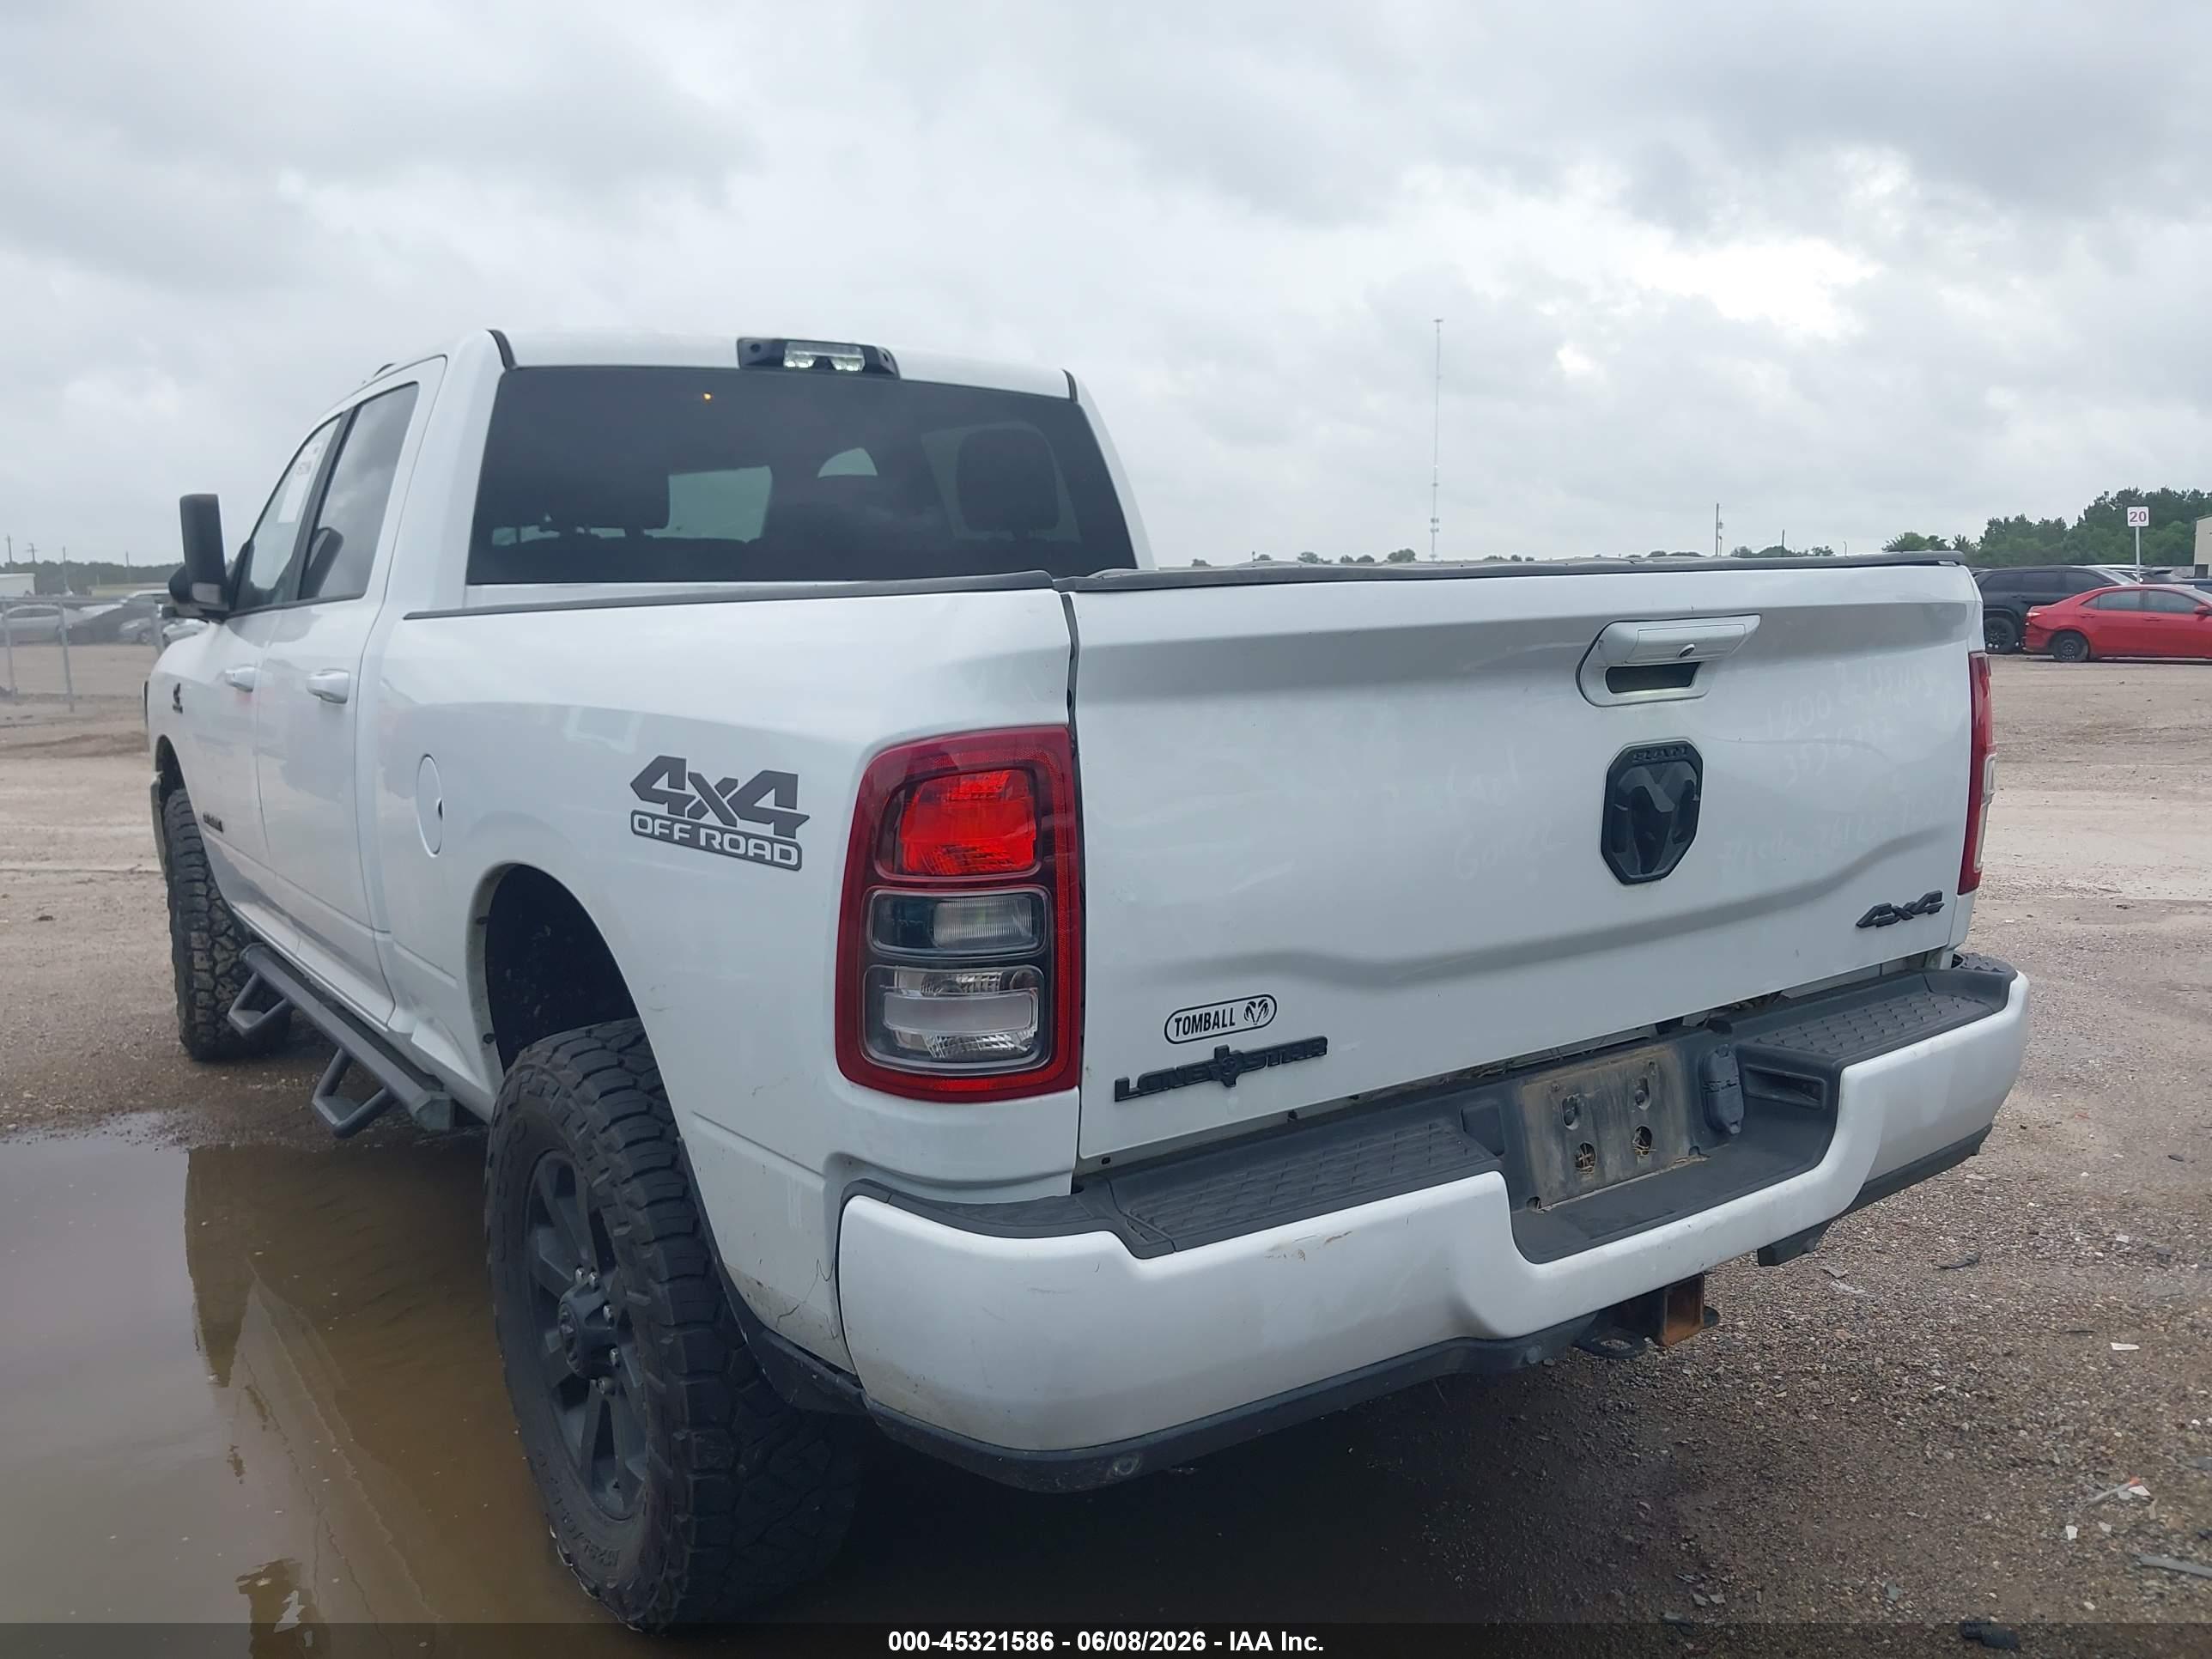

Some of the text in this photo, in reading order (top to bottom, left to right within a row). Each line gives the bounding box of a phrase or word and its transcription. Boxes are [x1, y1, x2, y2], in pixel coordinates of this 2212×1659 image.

[2129, 511, 2147, 523] 20
[633, 813, 799, 866] OFF ROAD
[1174, 1007, 1236, 1037] TOMBALL
